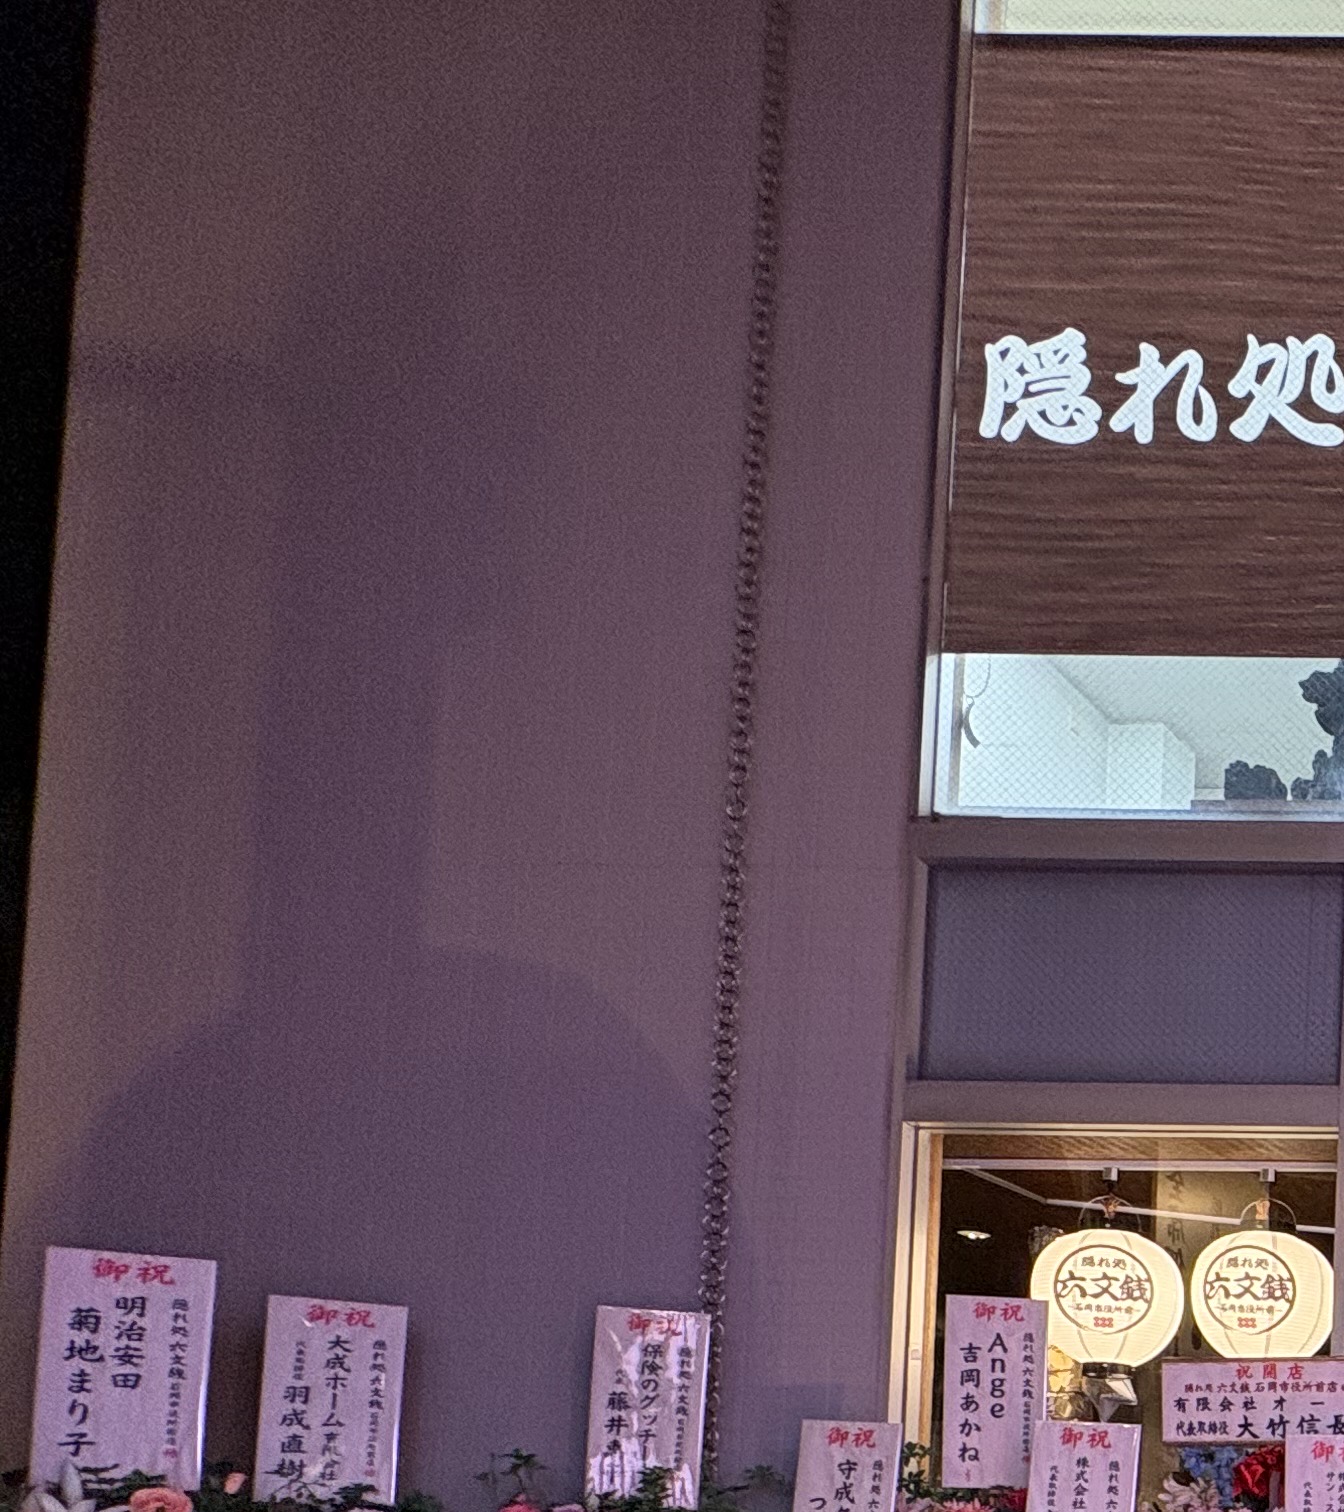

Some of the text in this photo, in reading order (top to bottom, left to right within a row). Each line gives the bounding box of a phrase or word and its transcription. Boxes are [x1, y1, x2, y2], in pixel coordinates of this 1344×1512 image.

[93, 1258, 175, 1285] 御祝
[1058, 1270, 1151, 1304] 六文銭
[1206, 1271, 1294, 1304] 六文銭
[307, 1304, 375, 1328] 御祝
[973, 1302, 1025, 1322] 御祝
[110, 1296, 147, 1390] 明治安田
[58, 1307, 105, 1457] 菊地まり子
[988, 1333, 1008, 1419] Ange
[958, 1342, 982, 1462] 吉岡あかね
[827, 1427, 877, 1449] 御祝
[1060, 1427, 1112, 1449] 御祝
